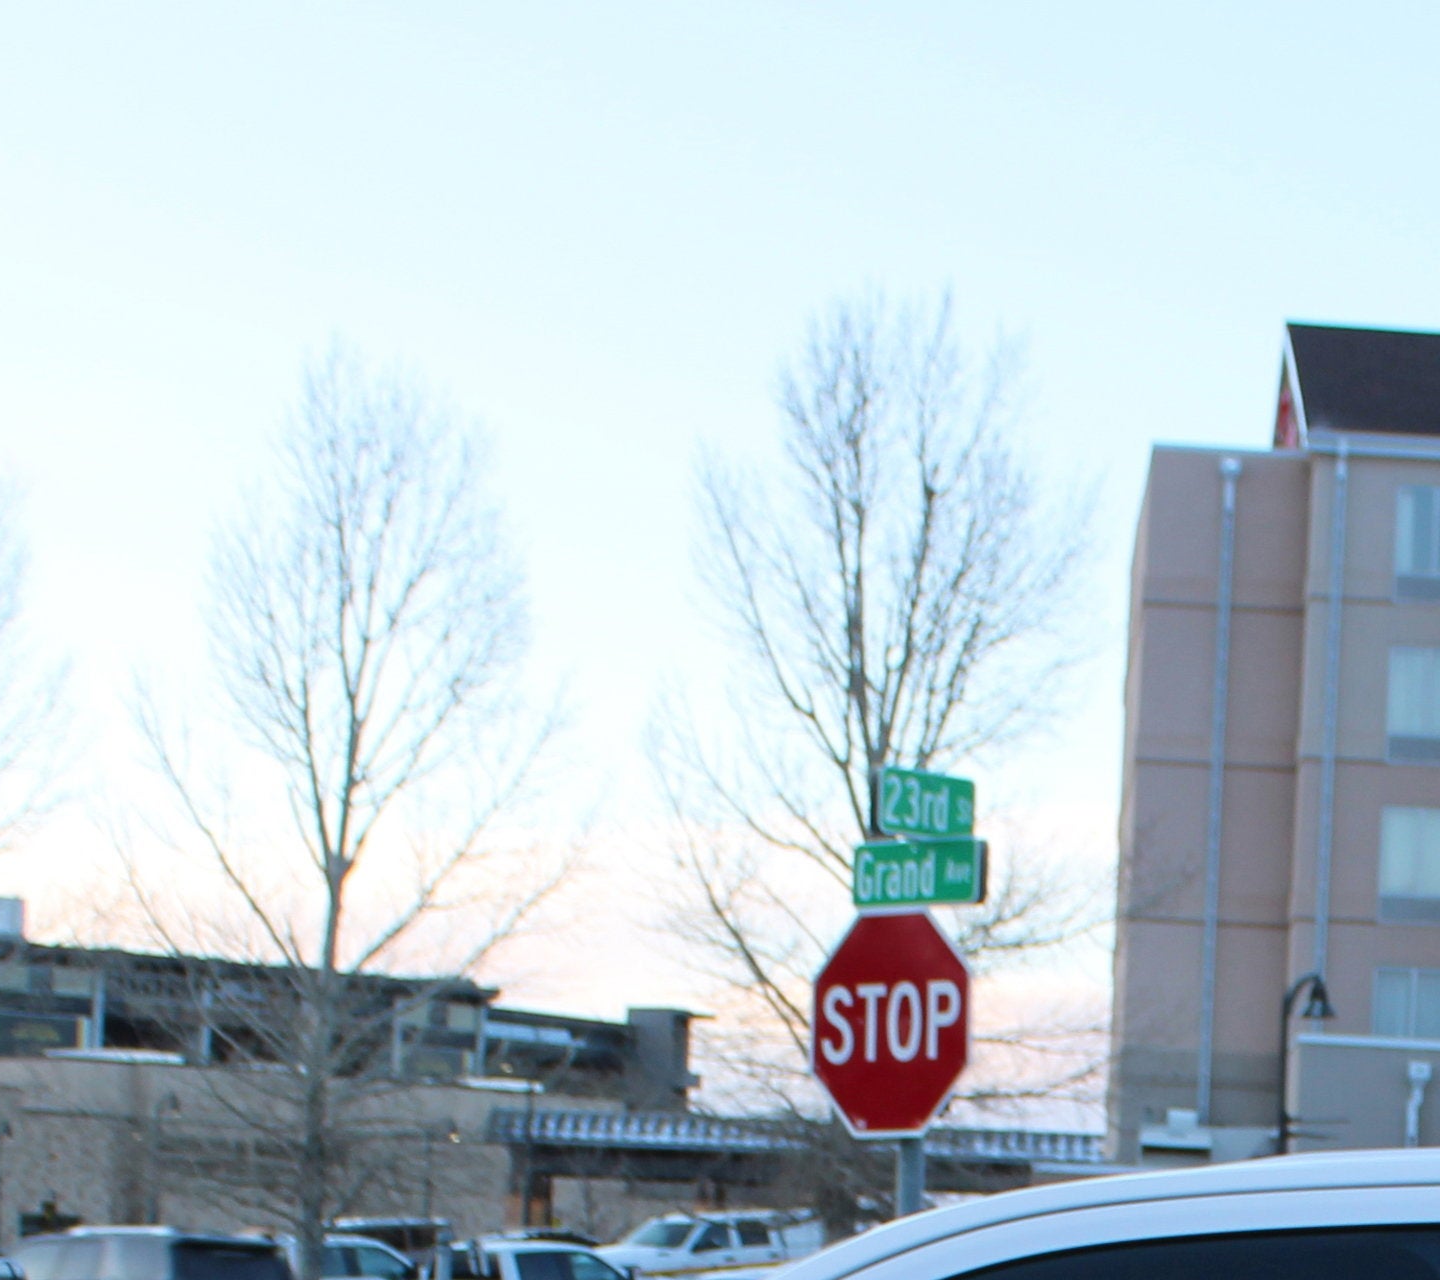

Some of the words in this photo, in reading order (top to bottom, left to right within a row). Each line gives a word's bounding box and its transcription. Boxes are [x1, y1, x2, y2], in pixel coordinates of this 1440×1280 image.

[883, 774, 949, 832] 23rd
[856, 849, 937, 901] Grand
[821, 980, 961, 1066] STOP
